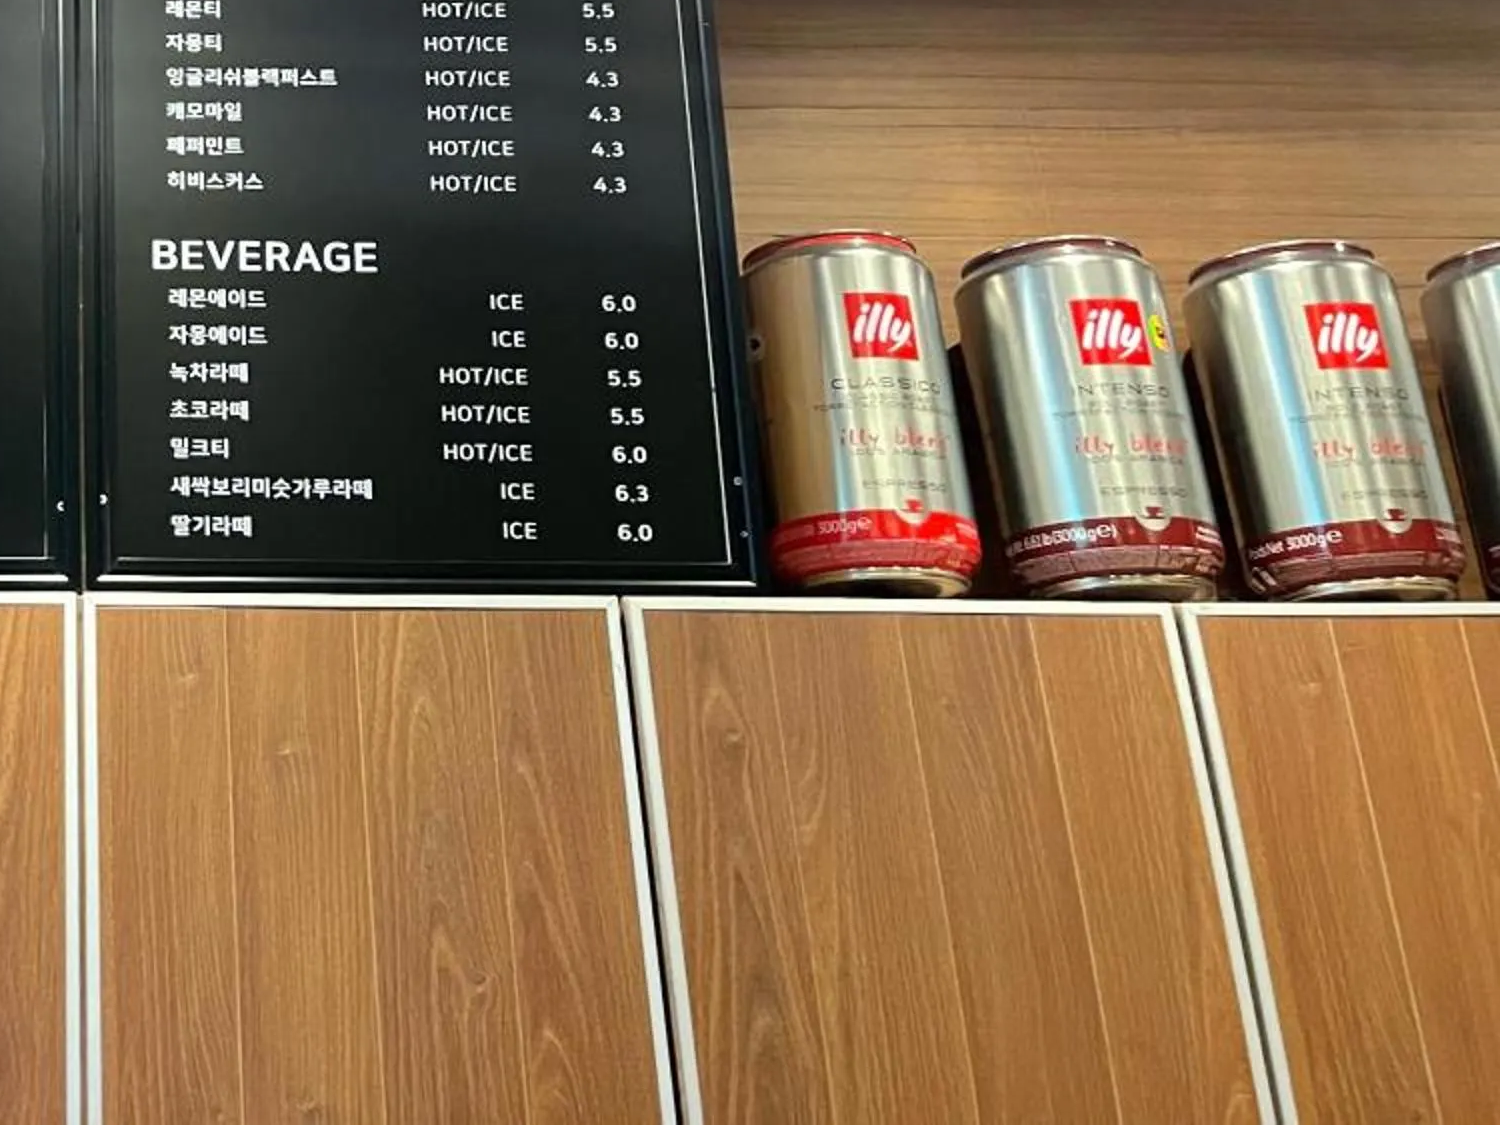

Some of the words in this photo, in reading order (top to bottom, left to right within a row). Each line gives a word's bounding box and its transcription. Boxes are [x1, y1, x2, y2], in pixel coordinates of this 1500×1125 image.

[165, 0, 221, 19] 레몬티
[422, 1, 507, 20] HOT/ICE
[582, 2, 615, 20] 5.5
[165, 32, 222, 53] 자몽티
[423, 35, 509, 54] HOT/ICE
[585, 36, 617, 54] 5.5
[425, 69, 511, 88] HOT/ICE
[585, 71, 619, 88] 4.3
[166, 101, 242, 122] 캐모마일
[427, 104, 512, 123] HOT/ICE
[588, 106, 622, 123] 4.3
[166, 136, 244, 156] 페퍼민트
[428, 138, 515, 158] HOT/ICE
[591, 140, 625, 158] 4.3
[167, 170, 264, 191] 히비스커스
[430, 174, 517, 194] HOT/ICE
[593, 176, 627, 194] 4.3
[151, 239, 378, 273] BEVERAGE
[168, 288, 267, 309] 레몬에이드
[489, 293, 524, 311] ICE
[601, 294, 637, 313] 6.0
[169, 324, 268, 346] 자몽에이드
[491, 330, 527, 348] ICE
[604, 332, 639, 350] 6.0
[852, 302, 913, 353] illy
[1082, 308, 1143, 359] illy
[1317, 312, 1381, 363] illy
[169, 362, 249, 384] 녹차라떼
[439, 366, 528, 386] HOT/ICE
[607, 369, 642, 388] 5.5
[831, 375, 942, 396] CLASSICO
[1072, 381, 1171, 398] NTENSO
[169, 399, 249, 421] 초코라떼
[441, 404, 531, 425] HOT/ICE
[610, 407, 645, 426] 5.5
[169, 437, 229, 460] 밀크티
[443, 442, 533, 463] HOT/ICE
[611, 445, 647, 464] 6.0
[1130, 432, 1188, 455] ble
[170, 476, 373, 500] 새싹보리미숫가루라떼
[500, 482, 535, 500] ICE
[615, 484, 649, 503] 6.3
[170, 514, 253, 537] 딸기라떼
[502, 521, 537, 540] ICE
[617, 523, 653, 542] 6.0
